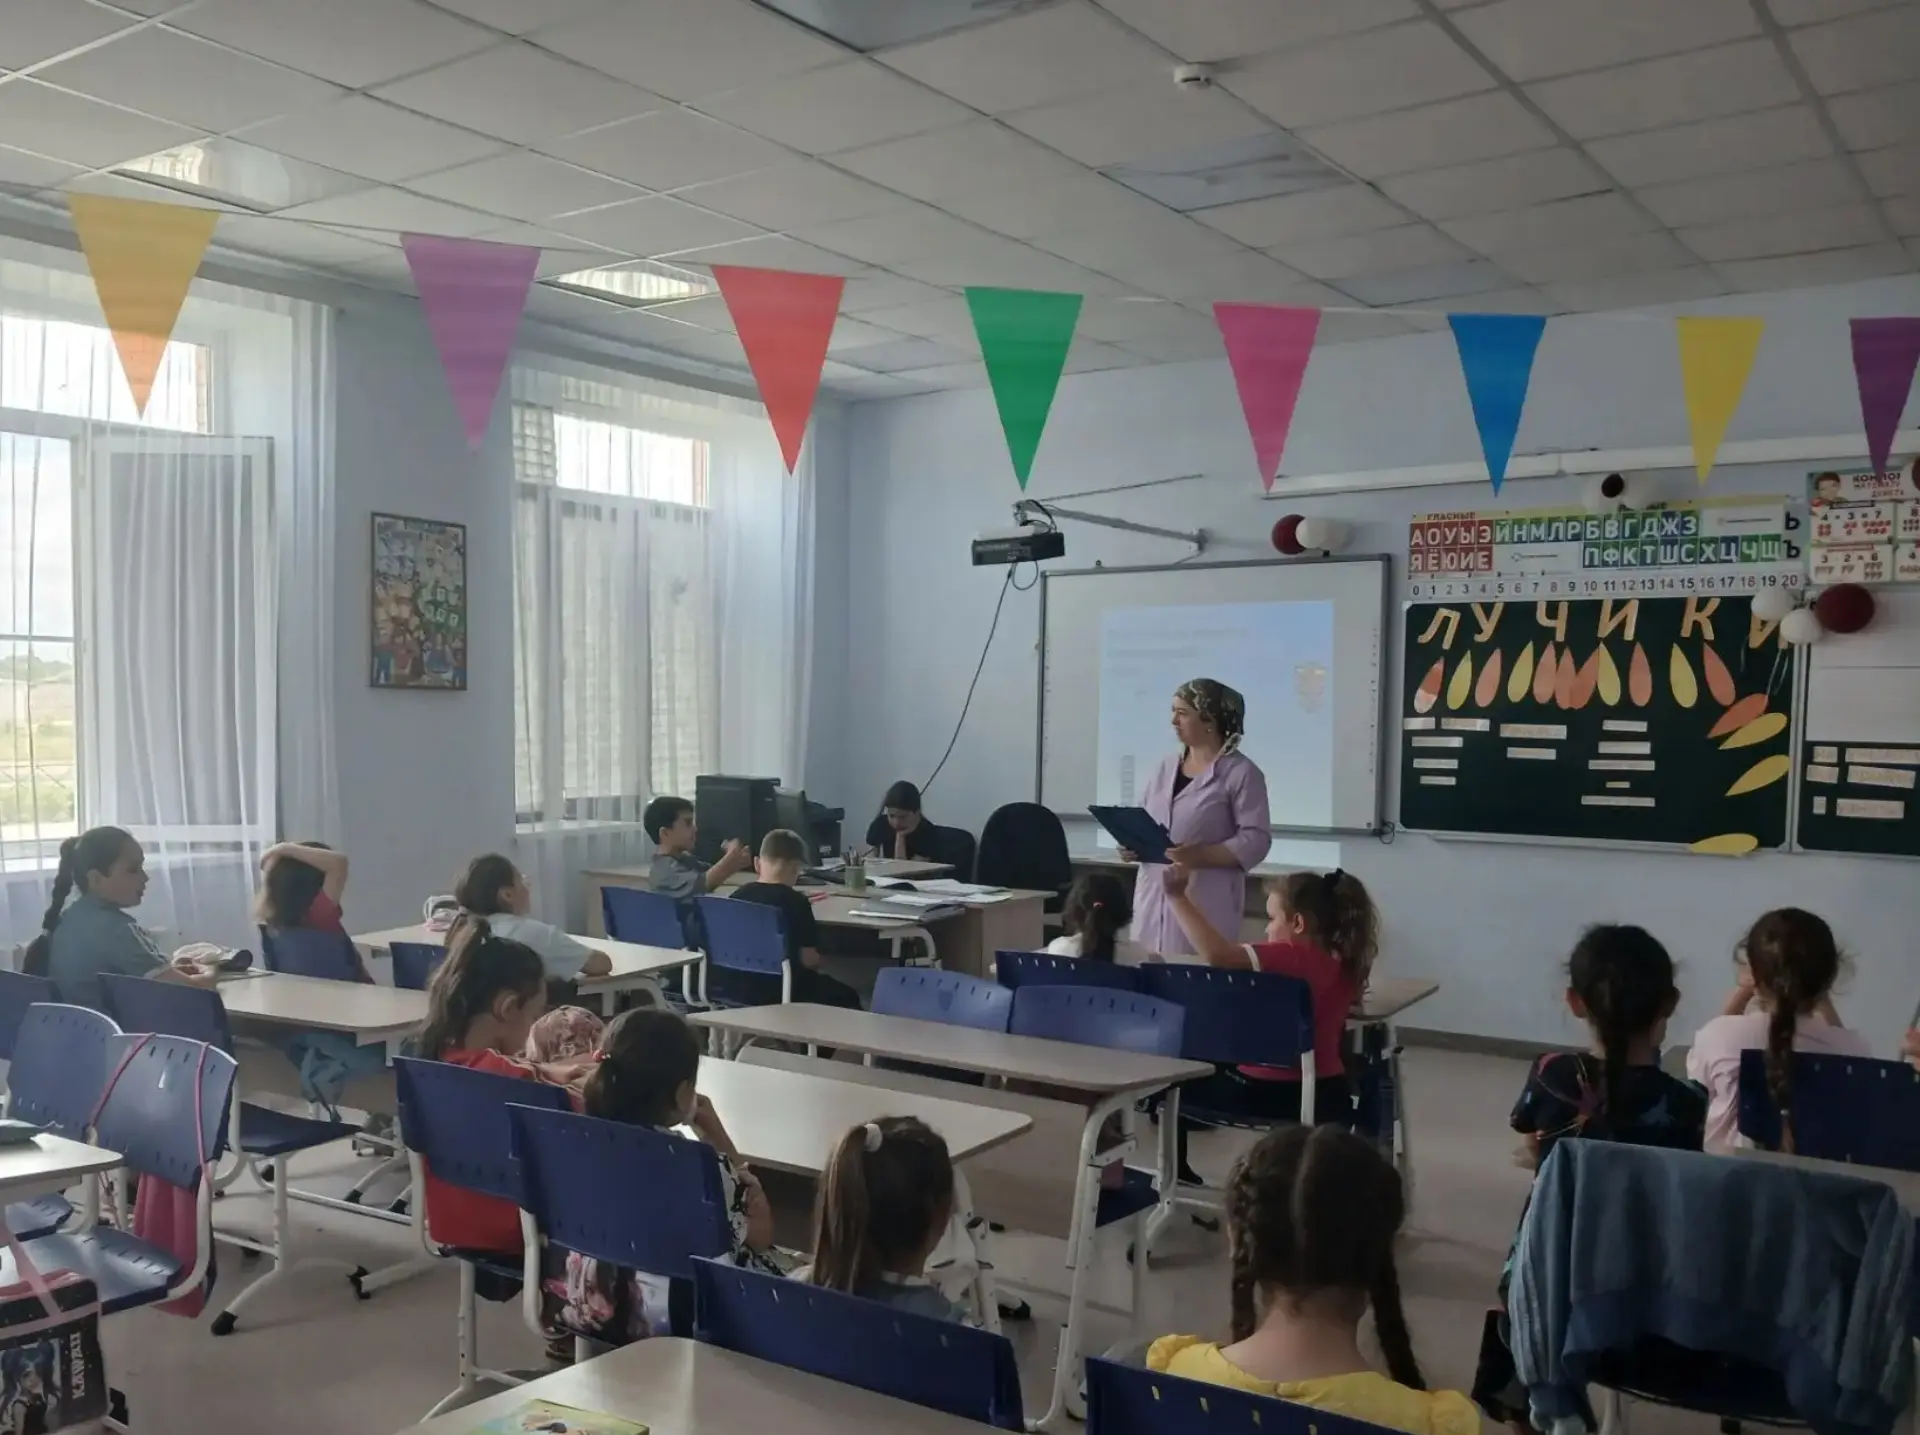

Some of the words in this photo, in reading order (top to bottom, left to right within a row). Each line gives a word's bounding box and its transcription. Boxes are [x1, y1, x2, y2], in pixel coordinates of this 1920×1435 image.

[1785, 511, 1800, 530] Ь
[1783, 540, 1800, 558] Ъ
[1413, 585, 1420, 596] 0
[1431, 585, 1436, 595] 1
[1446, 584, 1452, 594] 2
[1462, 584, 1469, 594] 3
[1480, 584, 1486, 593] 4
[1497, 582, 1504, 593] 5
[1514, 582, 1521, 593] 6
[1533, 582, 1539, 592] 7
[1551, 582, 1557, 592] 8
[1568, 581, 1576, 592] 9
[1584, 581, 1597, 591] 10
[1604, 580, 1616, 591] 11
[1622, 580, 1636, 590] 12
[1640, 579, 1654, 589] 13
[1660, 579, 1674, 589] 14
[1680, 578, 1694, 589] 15
[1700, 577, 1714, 588] 16
[1720, 577, 1735, 588] 17
[1741, 576, 1756, 587] 18
[1762, 575, 1776, 586] 19
[1781, 575, 1798, 587] 20
